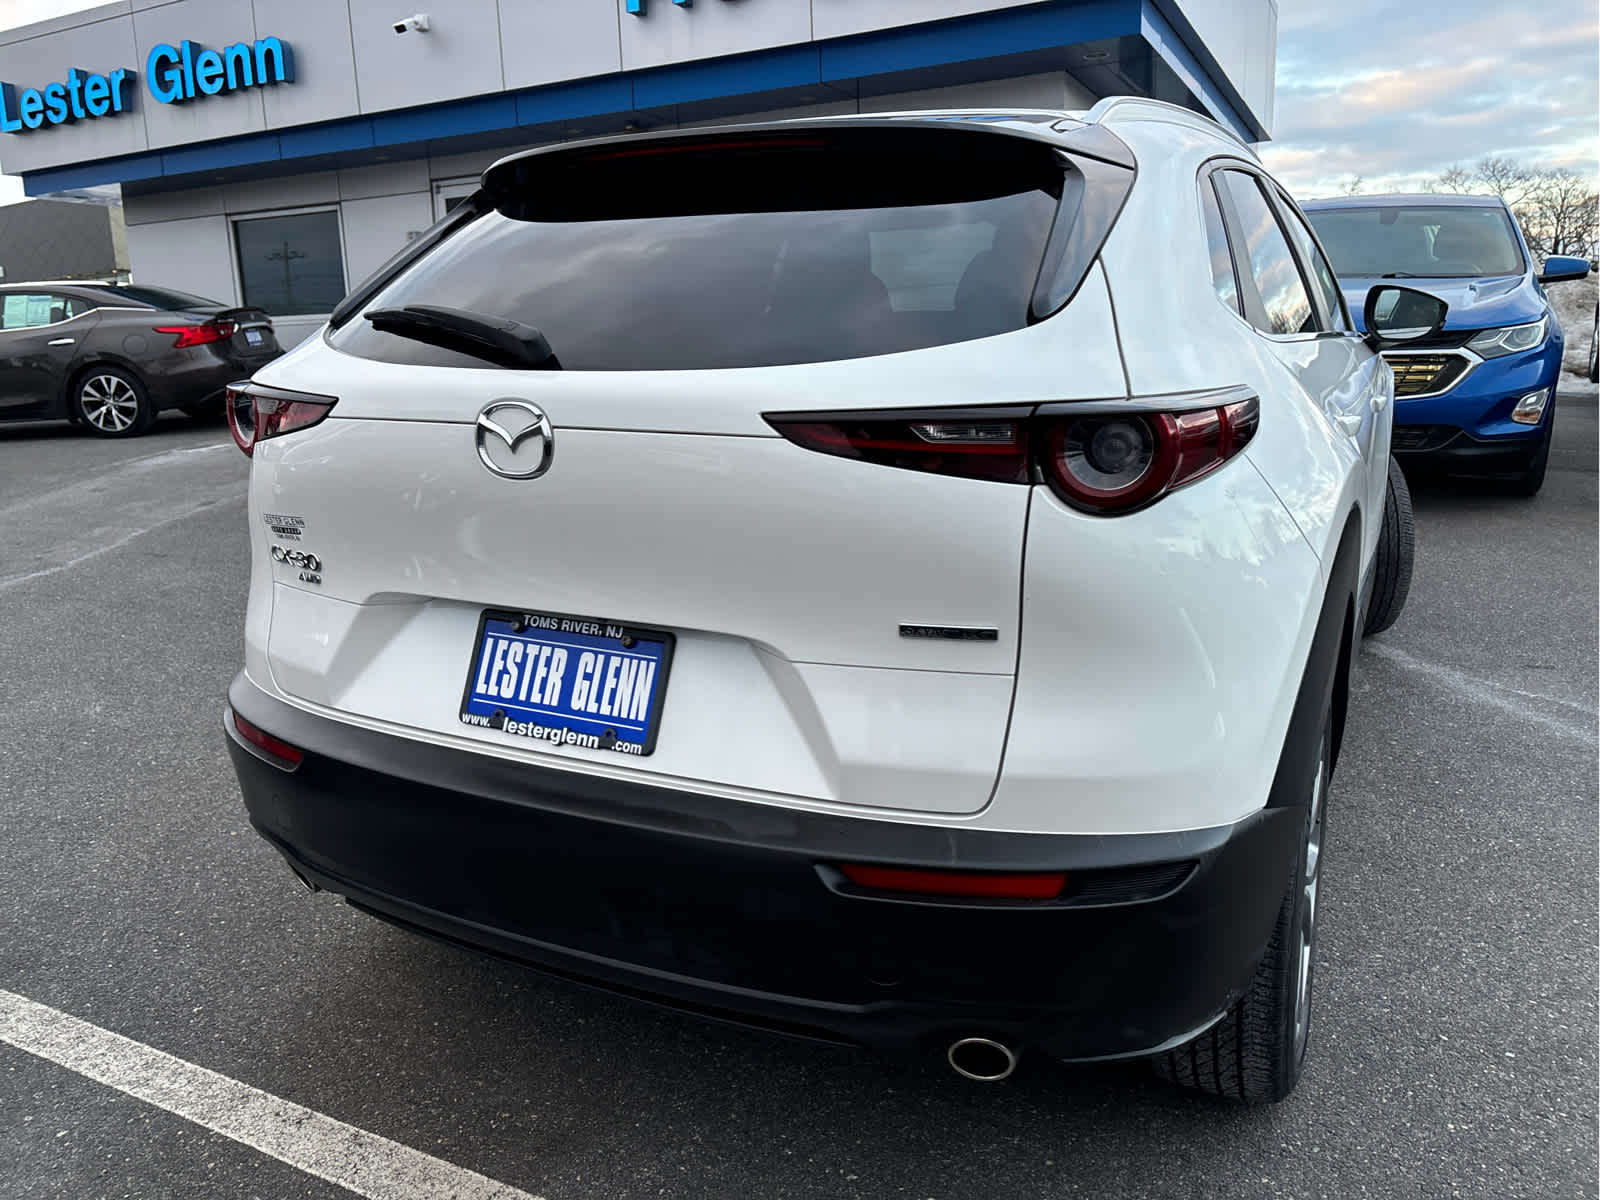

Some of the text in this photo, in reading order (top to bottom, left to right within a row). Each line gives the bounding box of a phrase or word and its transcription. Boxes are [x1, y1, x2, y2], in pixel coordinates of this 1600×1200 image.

[0, 36, 286, 133] Lester Glenn
[271, 544, 321, 571] CX-30
[523, 615, 624, 639] TOMS RIVER, NJ
[475, 637, 656, 722] LESTER GLENN
[461, 713, 642, 755] www. lesterglenn .com
